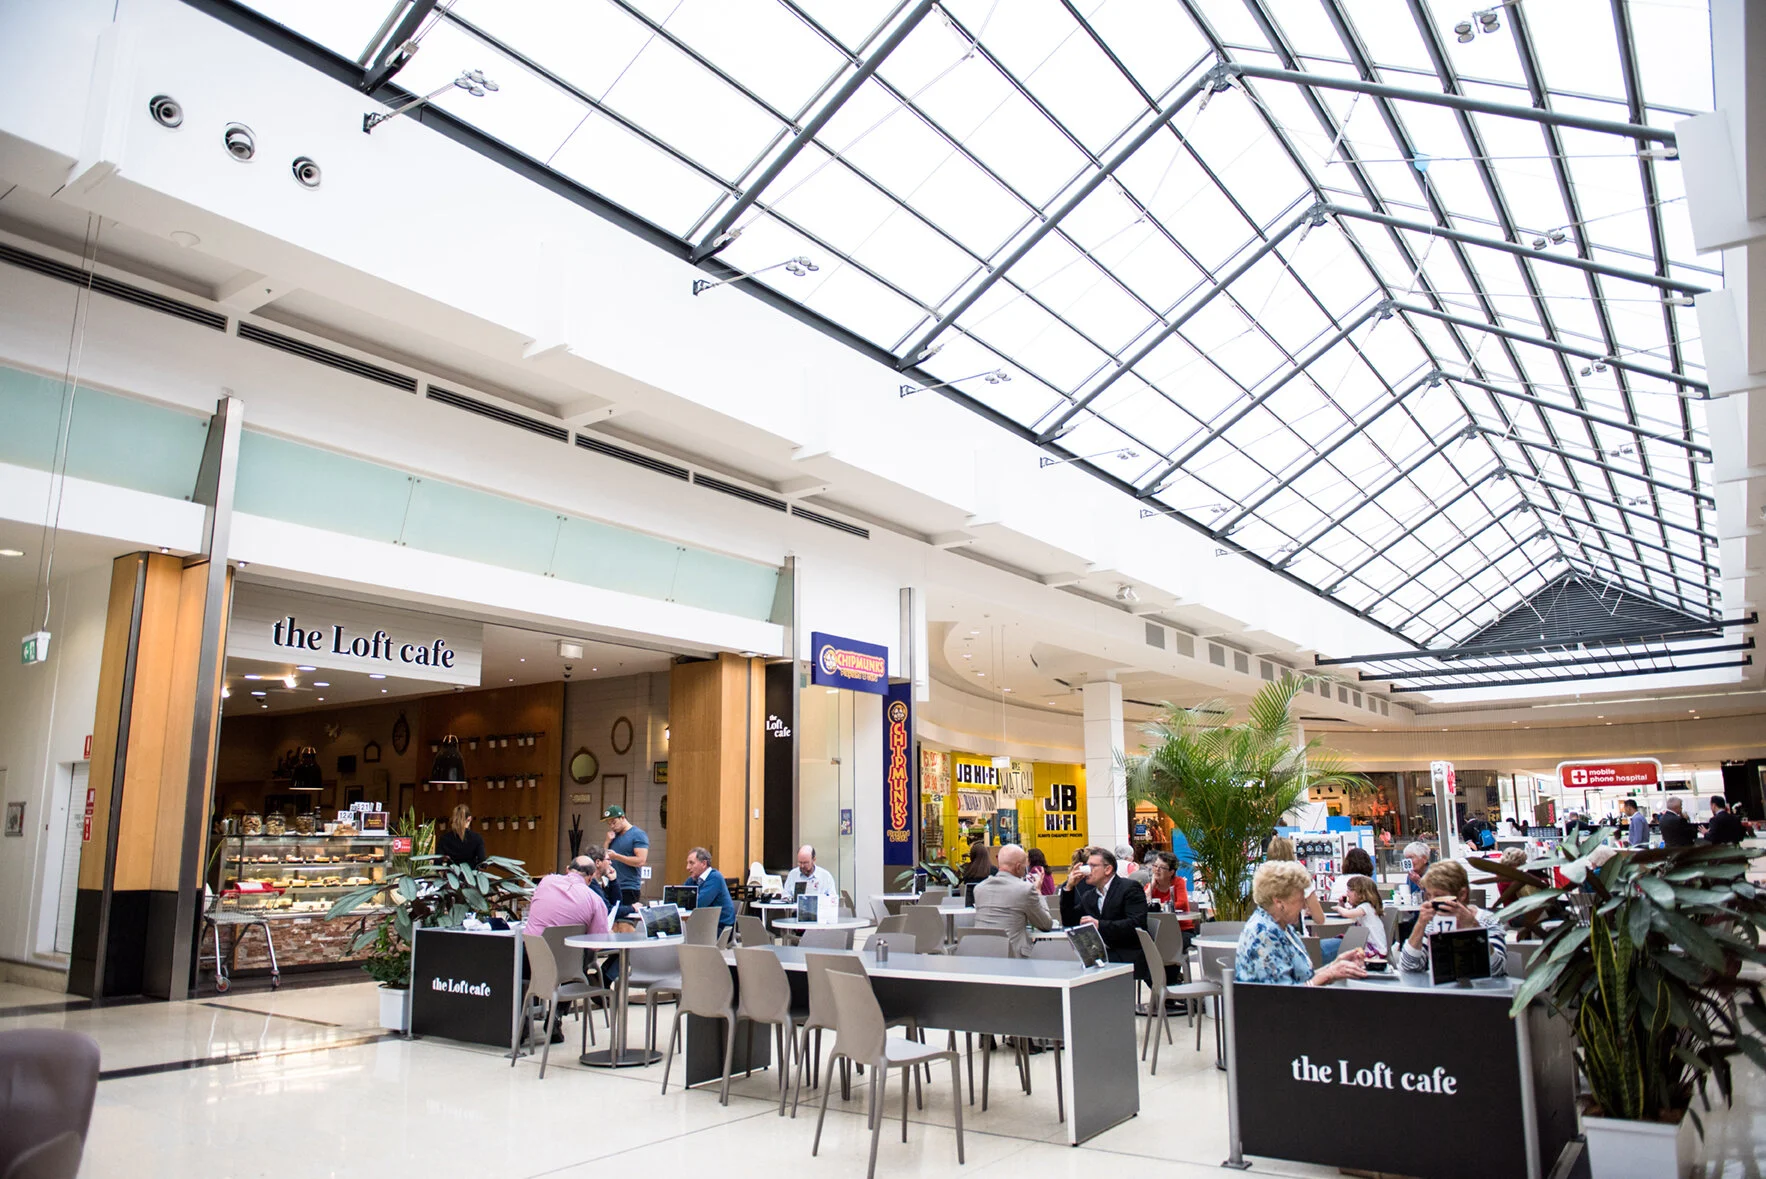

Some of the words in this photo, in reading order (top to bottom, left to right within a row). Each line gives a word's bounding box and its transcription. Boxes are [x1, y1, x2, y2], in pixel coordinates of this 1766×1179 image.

[273, 616, 323, 650] the
[332, 624, 394, 661] Loft
[400, 639, 455, 668] cafe
[837, 652, 884, 675] CHIPMUNKS
[766, 719, 783, 730] Loft
[774, 726, 791, 737] cafe
[891, 721, 907, 827] CHIPMUNKS
[957, 763, 972, 783] JB
[1588, 768, 1615, 776] mobile
[1590, 776, 1614, 784] phone
[1615, 773, 1647, 782] hospital
[1000, 771, 1033, 795] WATCH
[1044, 783, 1077, 812] JB
[1438, 920, 1453, 932] 17
[432, 977, 447, 991] the
[448, 978, 468, 994] Loft
[469, 982, 491, 997] cafe
[1291, 1055, 1333, 1084] the
[1338, 1059, 1395, 1090] Loft
[1400, 1066, 1458, 1095] cafe
